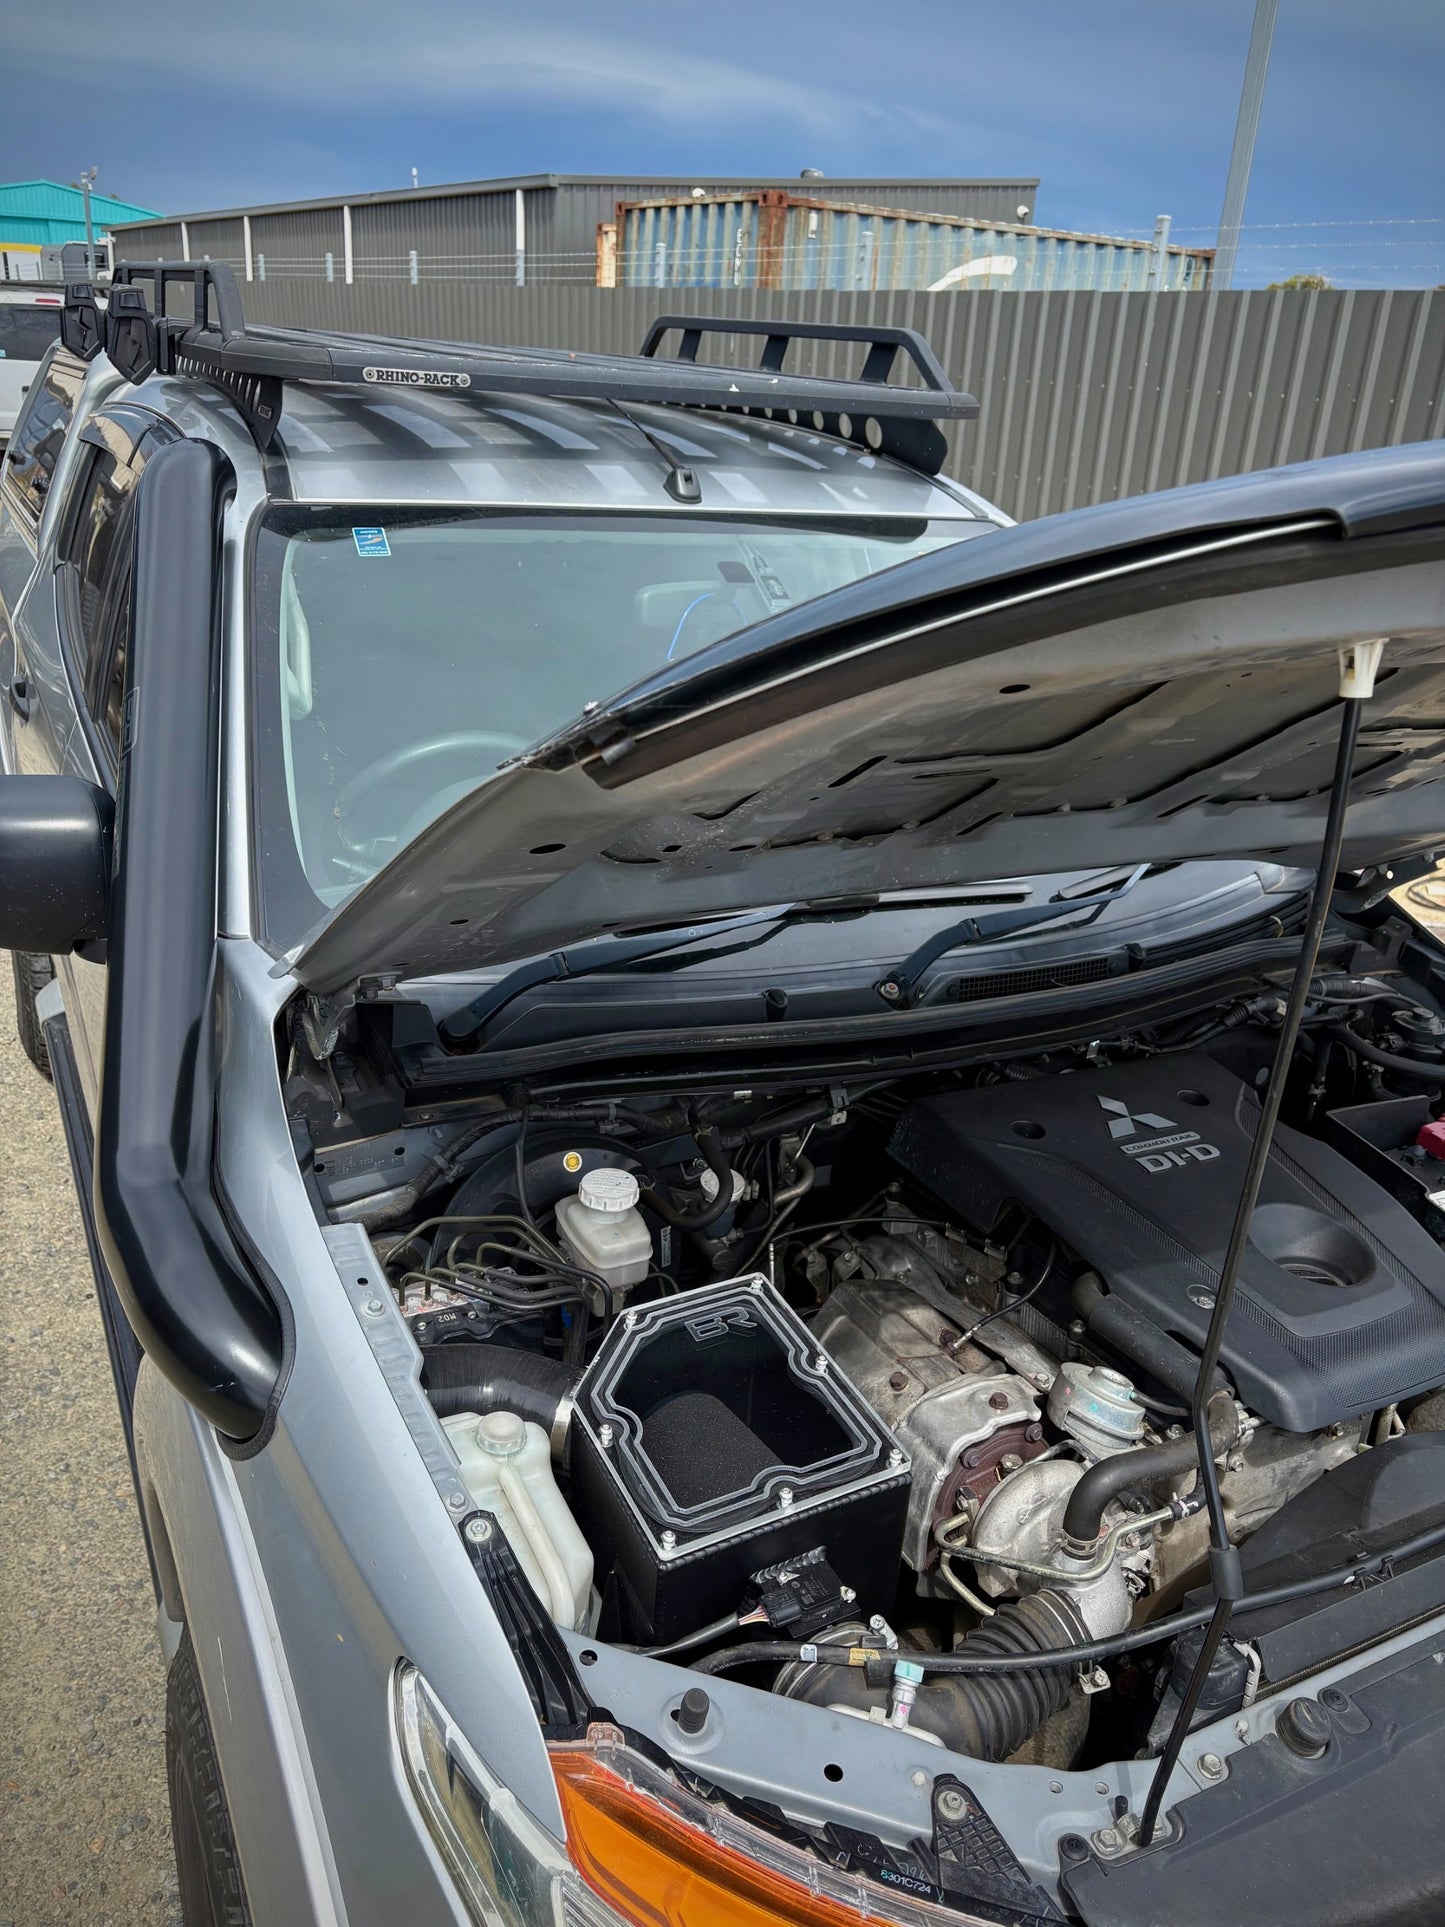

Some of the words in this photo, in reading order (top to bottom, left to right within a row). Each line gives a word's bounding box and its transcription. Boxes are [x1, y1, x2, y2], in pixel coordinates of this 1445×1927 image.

[375, 369, 461, 386] RHINO-RACK
[1134, 1143, 1221, 1174] DI-D
[880, 1869, 932, 1894] 8301C724
